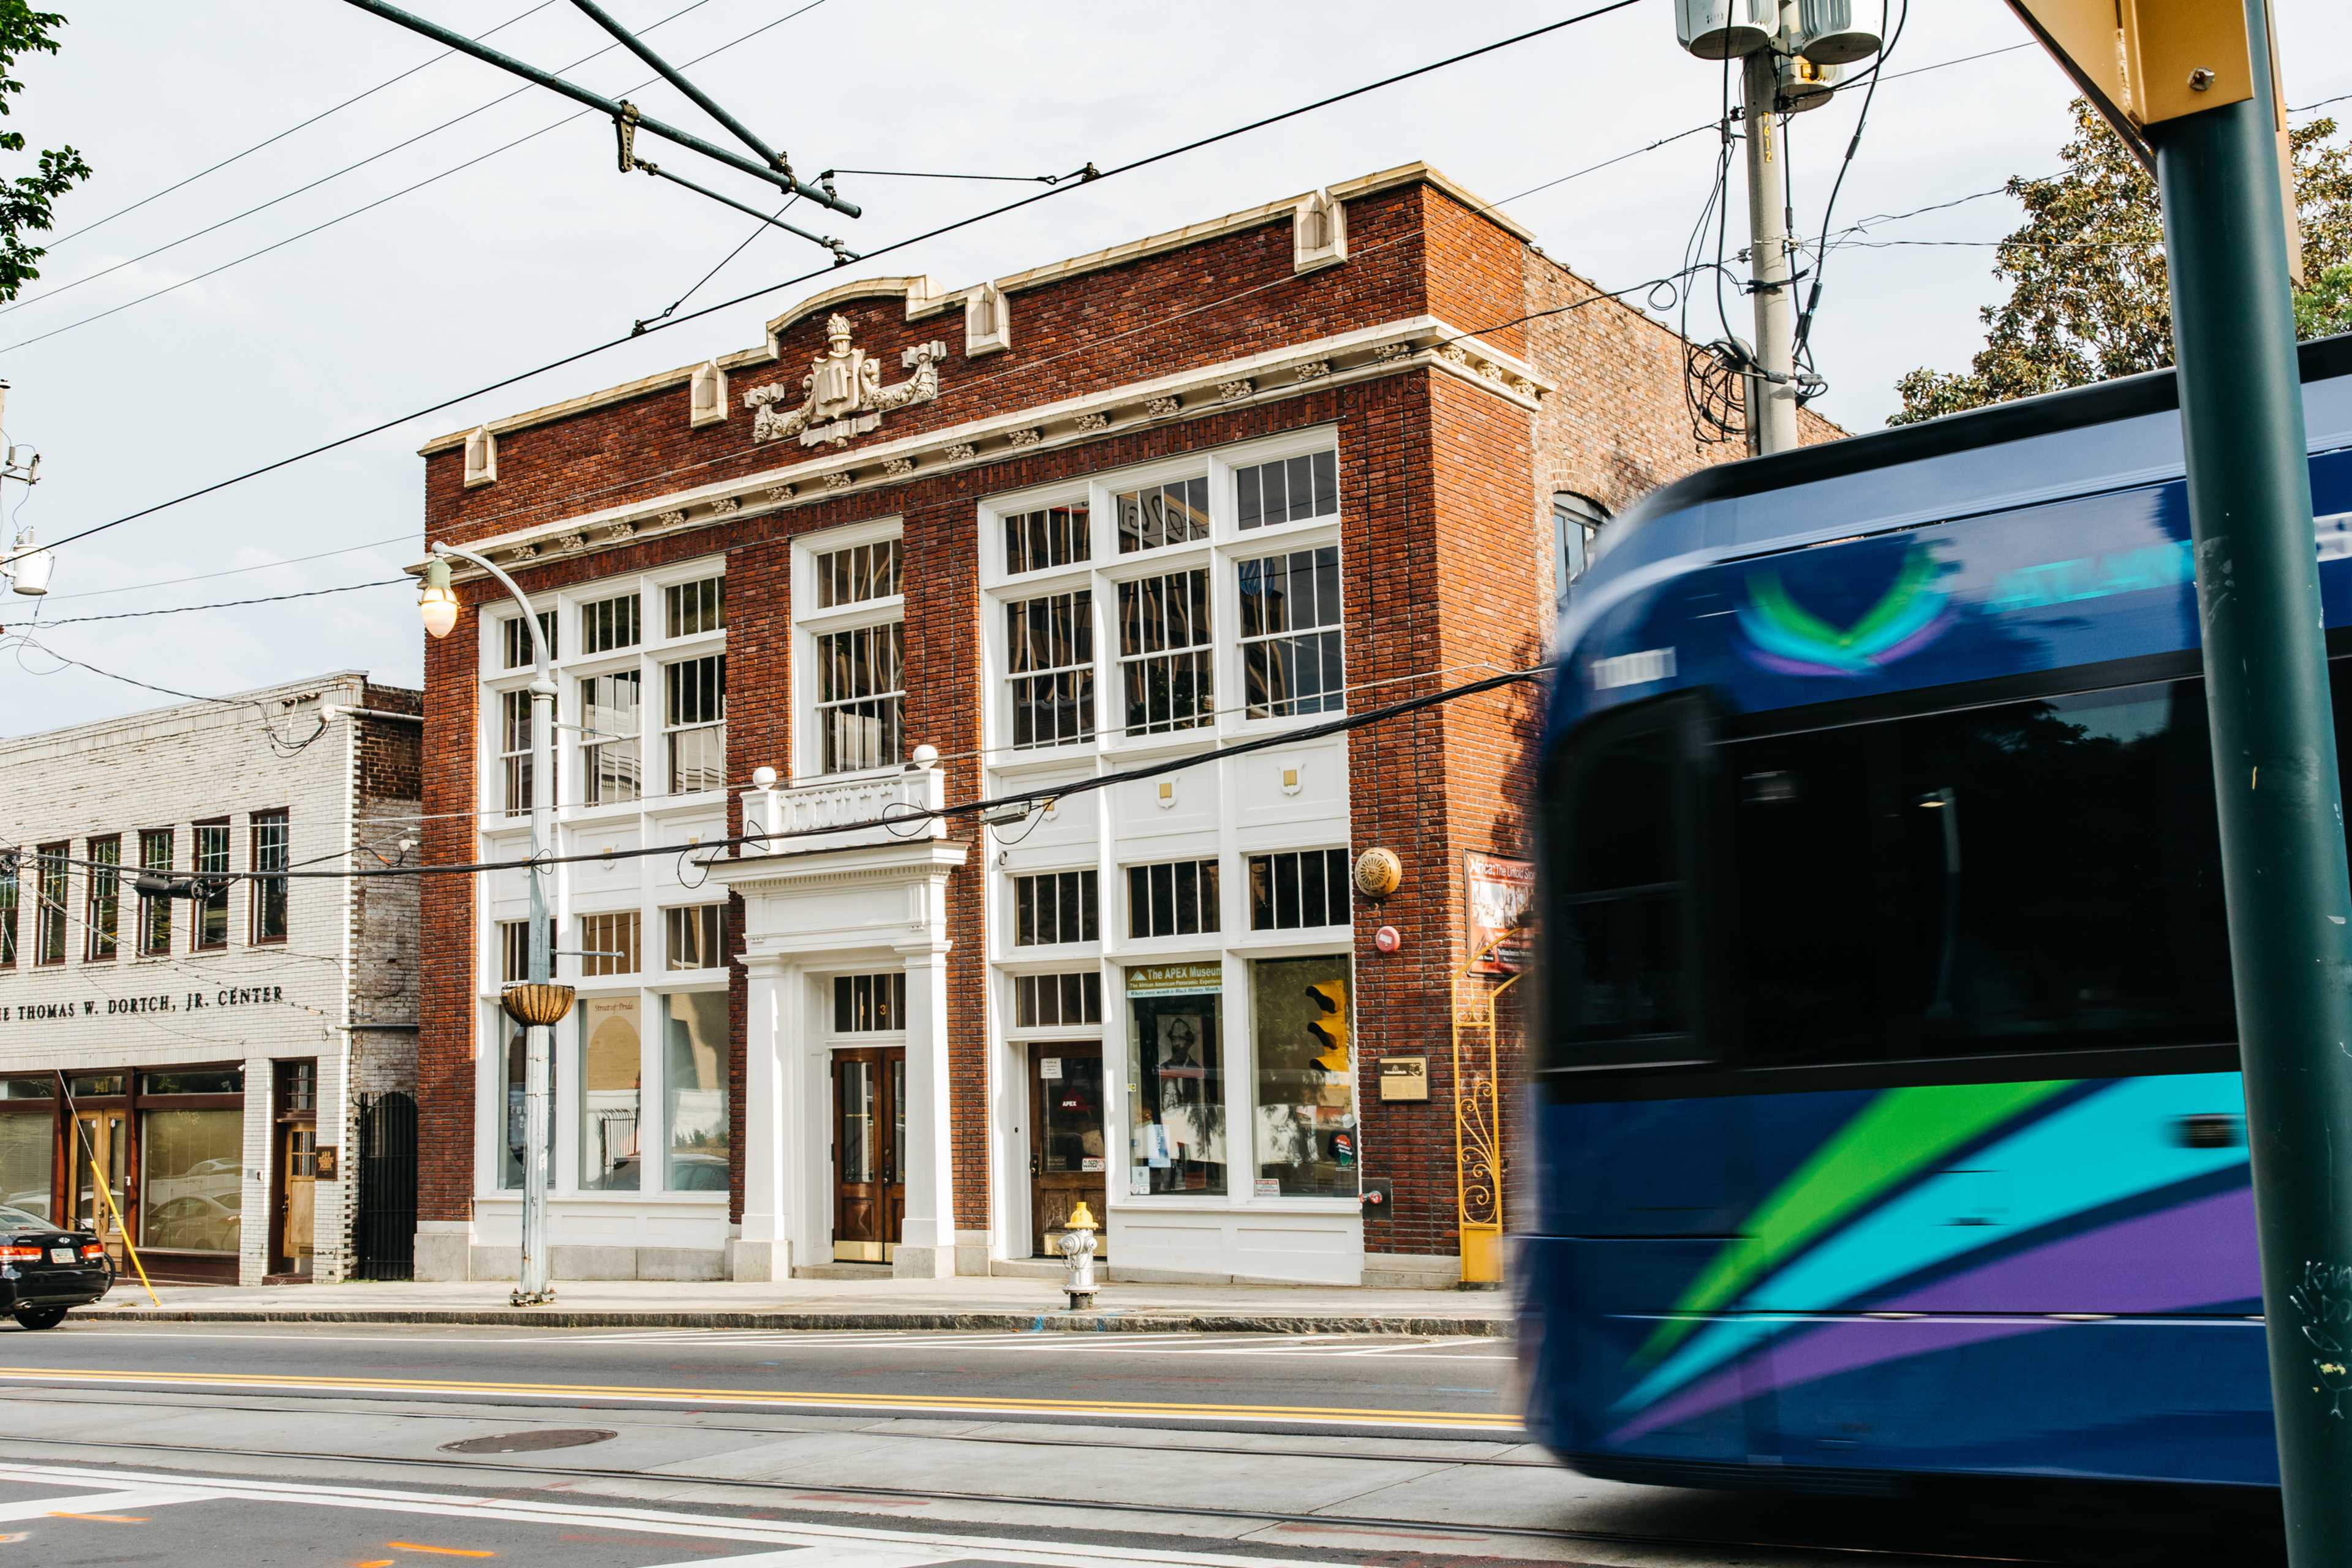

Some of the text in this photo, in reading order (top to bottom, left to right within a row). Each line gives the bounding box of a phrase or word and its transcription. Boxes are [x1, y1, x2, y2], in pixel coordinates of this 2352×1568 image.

[1763, 112, 1772, 162] 7612
[1470, 858, 1495, 875] Africa:
[1495, 864, 1506, 876] The
[1507, 865, 1524, 878] Untold
[1147, 966, 1221, 980] The APEX Museum
[18, 1003, 74, 1020] THOMAS
[84, 1001, 99, 1015] W.
[108, 995, 176, 1014] DORTCH,
[186, 993, 209, 1011] JR.
[218, 986, 282, 1006] CENTER
[1083, 1159, 1098, 1168] CLOSED
